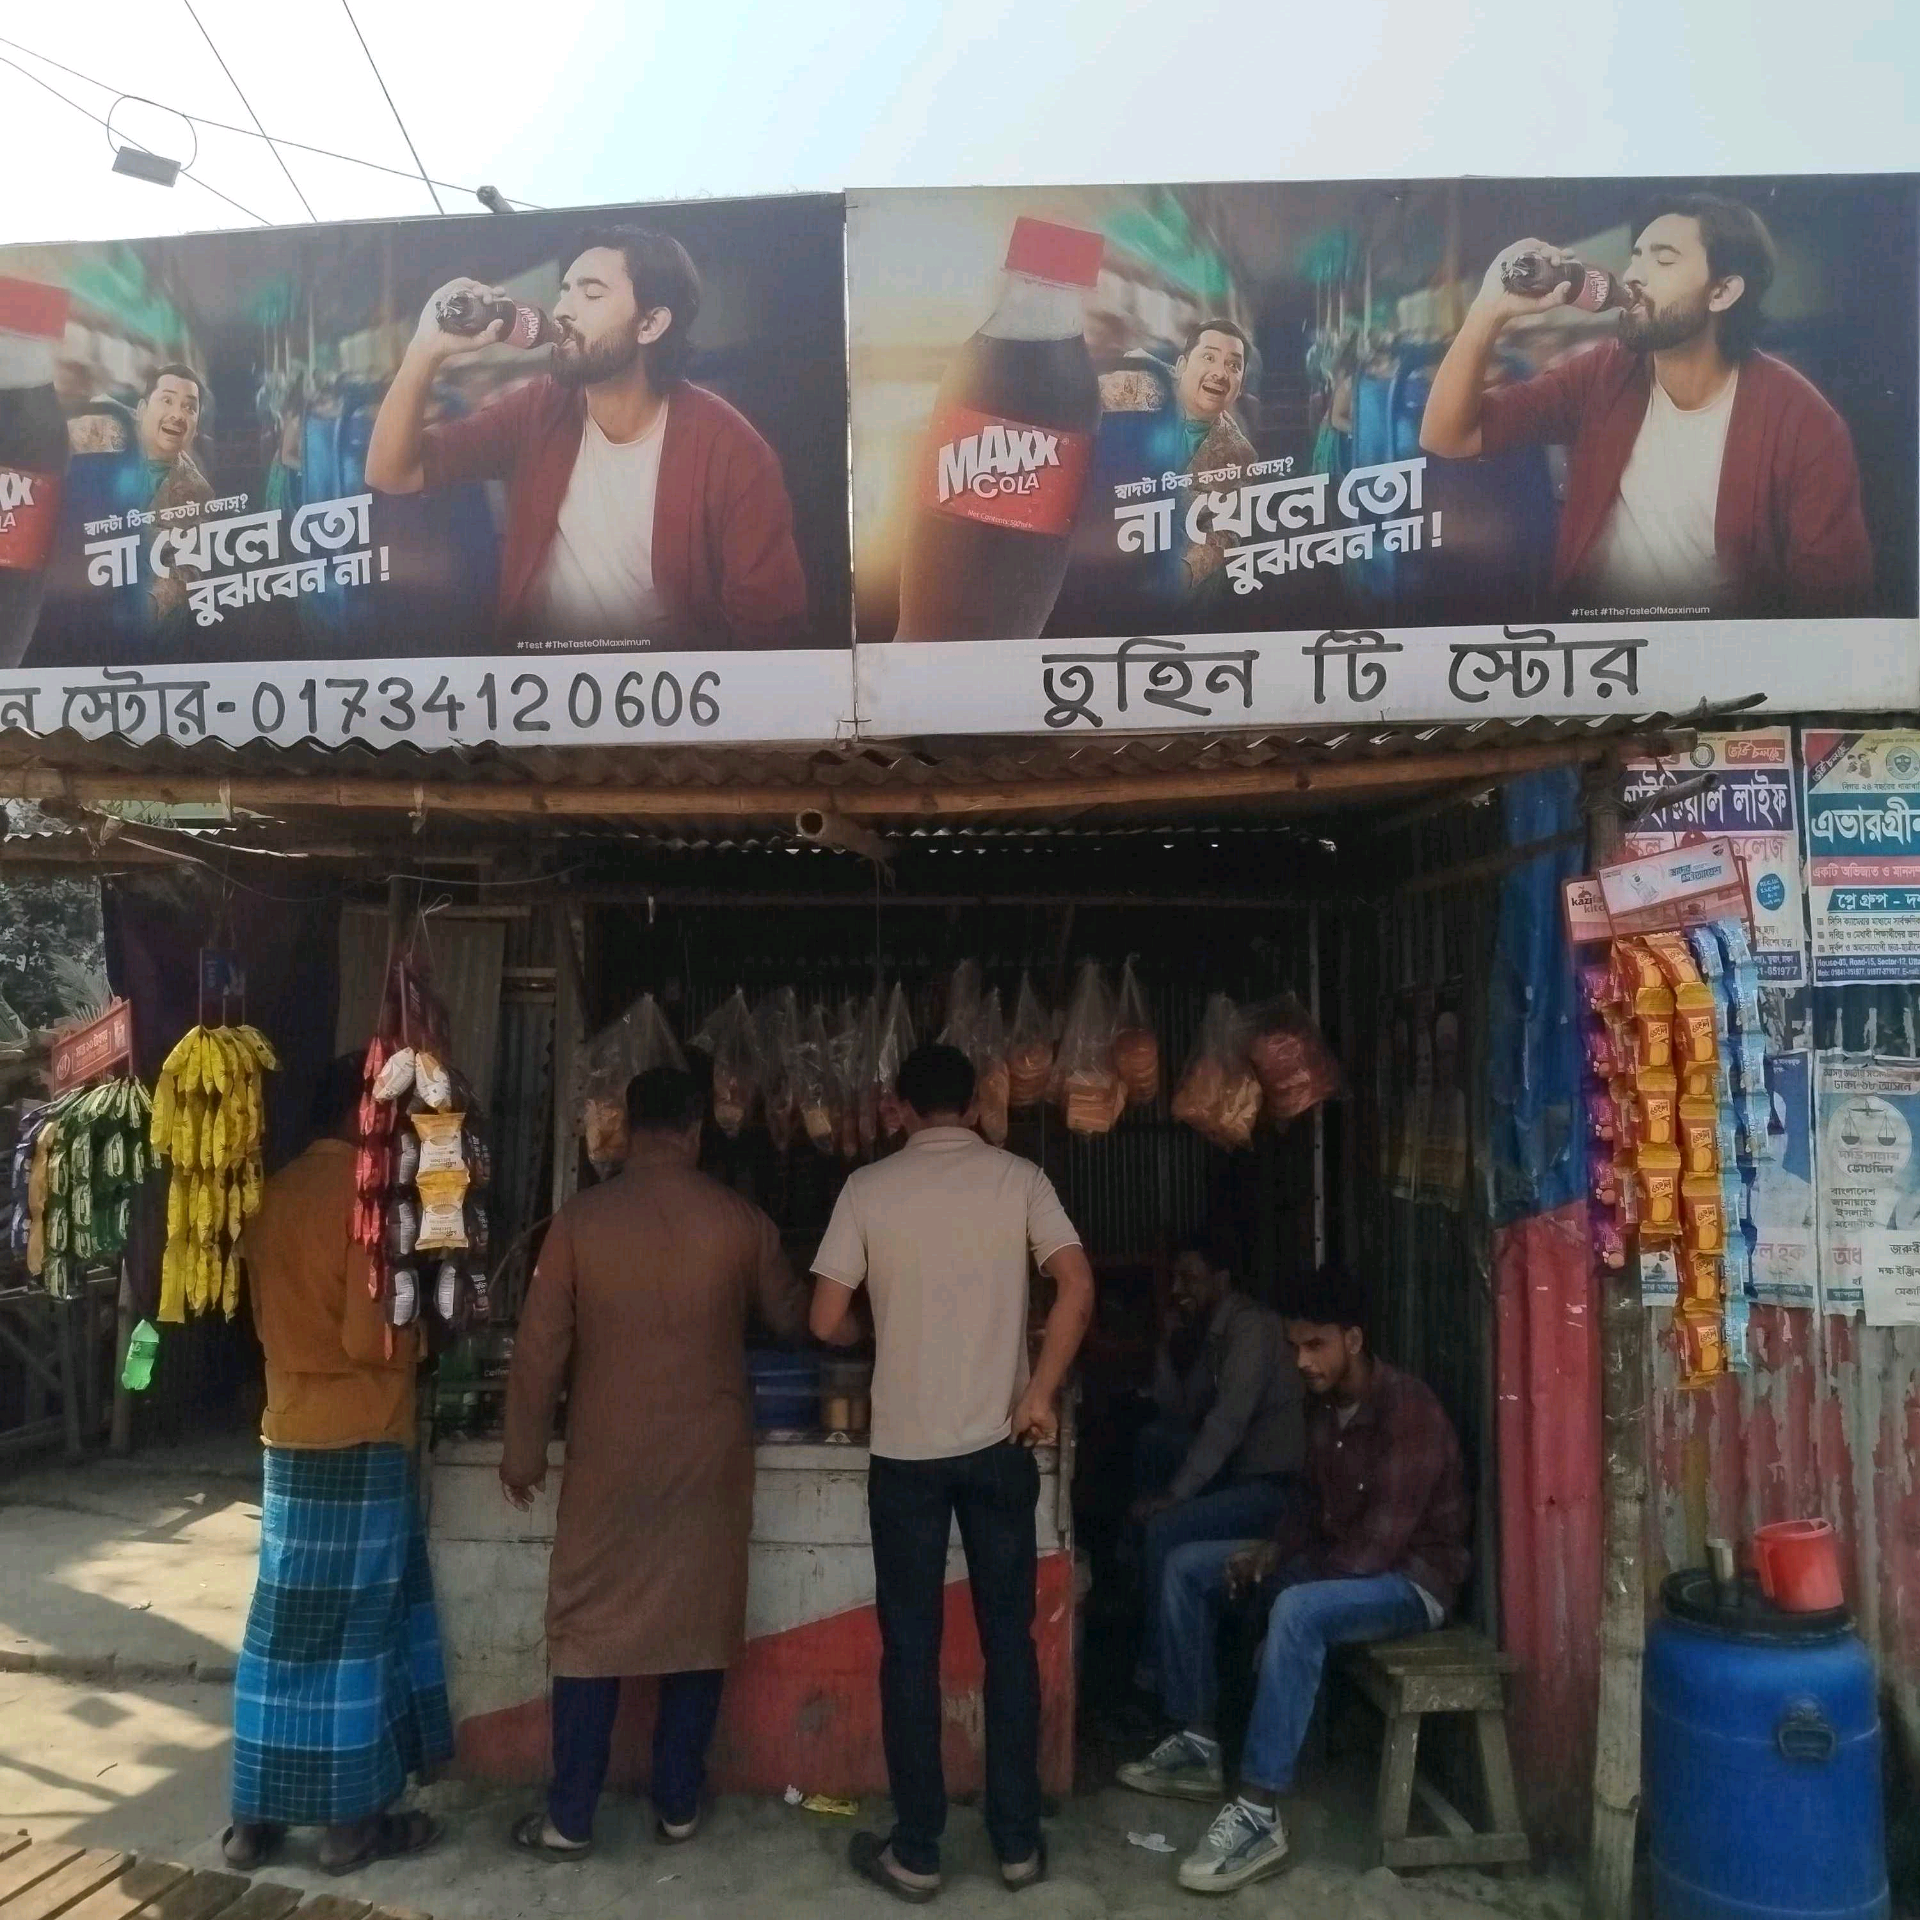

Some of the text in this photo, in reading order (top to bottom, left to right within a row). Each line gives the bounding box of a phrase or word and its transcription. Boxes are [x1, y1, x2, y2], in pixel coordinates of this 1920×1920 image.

[939, 425, 1060, 504] MAXX
[1115, 477, 1156, 499] স্বাদটা
[1161, 471, 1193, 492] ঠিক
[1198, 463, 1241, 485] কতটা
[972, 472, 1040, 499] COLA
[84, 514, 123, 536] স্বাদটা
[126, 508, 156, 529] ঠিক
[159, 502, 200, 522] কতটা
[1114, 457, 1426, 554] না খেলে তো
[84, 493, 373, 589] না খেলে তো
[1224, 524, 1375, 595] বুঝবেন
[186, 558, 327, 627] বুঝবেন
[1571, 606, 1710, 617] #Test #TheTasteOfMaxximum
[517, 638, 651, 650] #Test #TheTasteOfMaxximum
[1042, 625, 1648, 728] তুহিন টি স্টোর
[1730, 769, 1788, 828] লাইফ
[1812, 862, 1839, 878] একটি
[1841, 862, 1879, 878] অভিজাত
[1882, 866, 1890, 877] ও
[1571, 898, 1592, 907] kazi
[1836, 893, 1857, 910] প্লে
[1860, 893, 1888, 909] গ্রুপ
[1830, 1187, 1876, 1196] বাংলাদেশ
